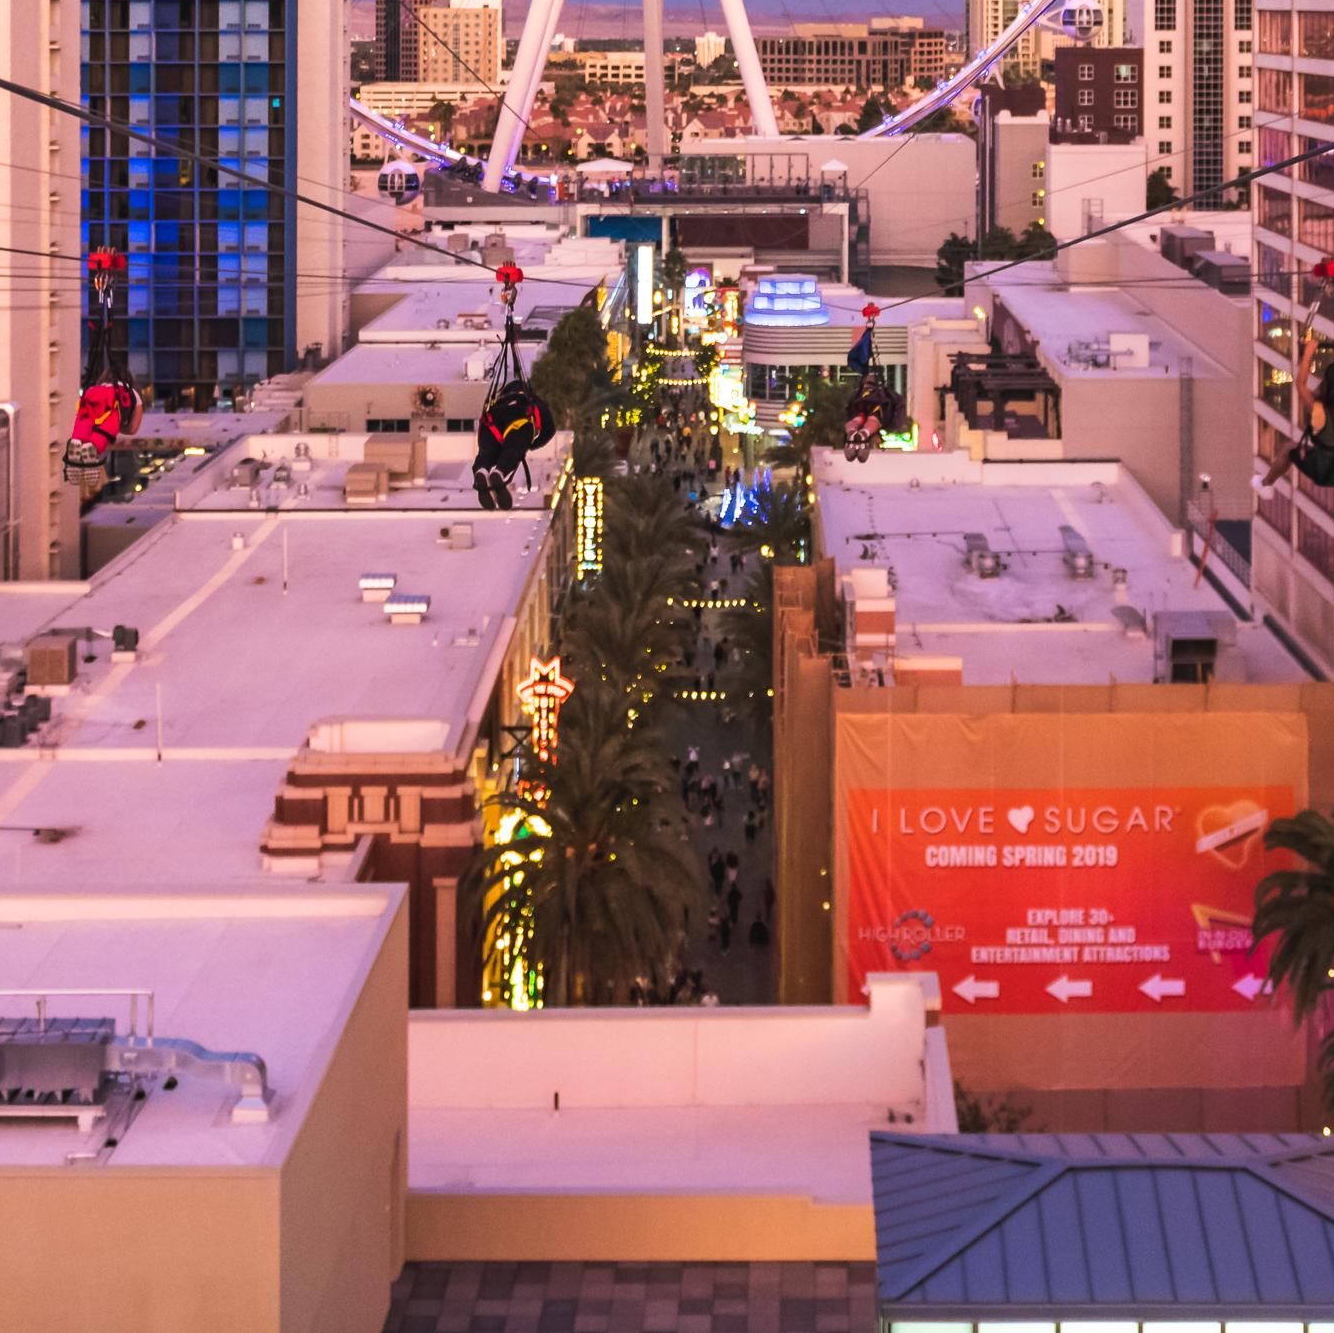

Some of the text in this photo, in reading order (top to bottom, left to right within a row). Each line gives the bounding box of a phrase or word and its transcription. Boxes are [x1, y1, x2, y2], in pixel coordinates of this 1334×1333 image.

[871, 806, 1174, 834] I LOVE SUGAR
[925, 845, 1118, 868] COMING SPRING 2019
[1027, 908, 1085, 926] EXPLORE
[1005, 927, 1136, 945] RETAIL, DINING AND
[971, 945, 1171, 963] ENTERTAINMENT ATTRACTIONS
